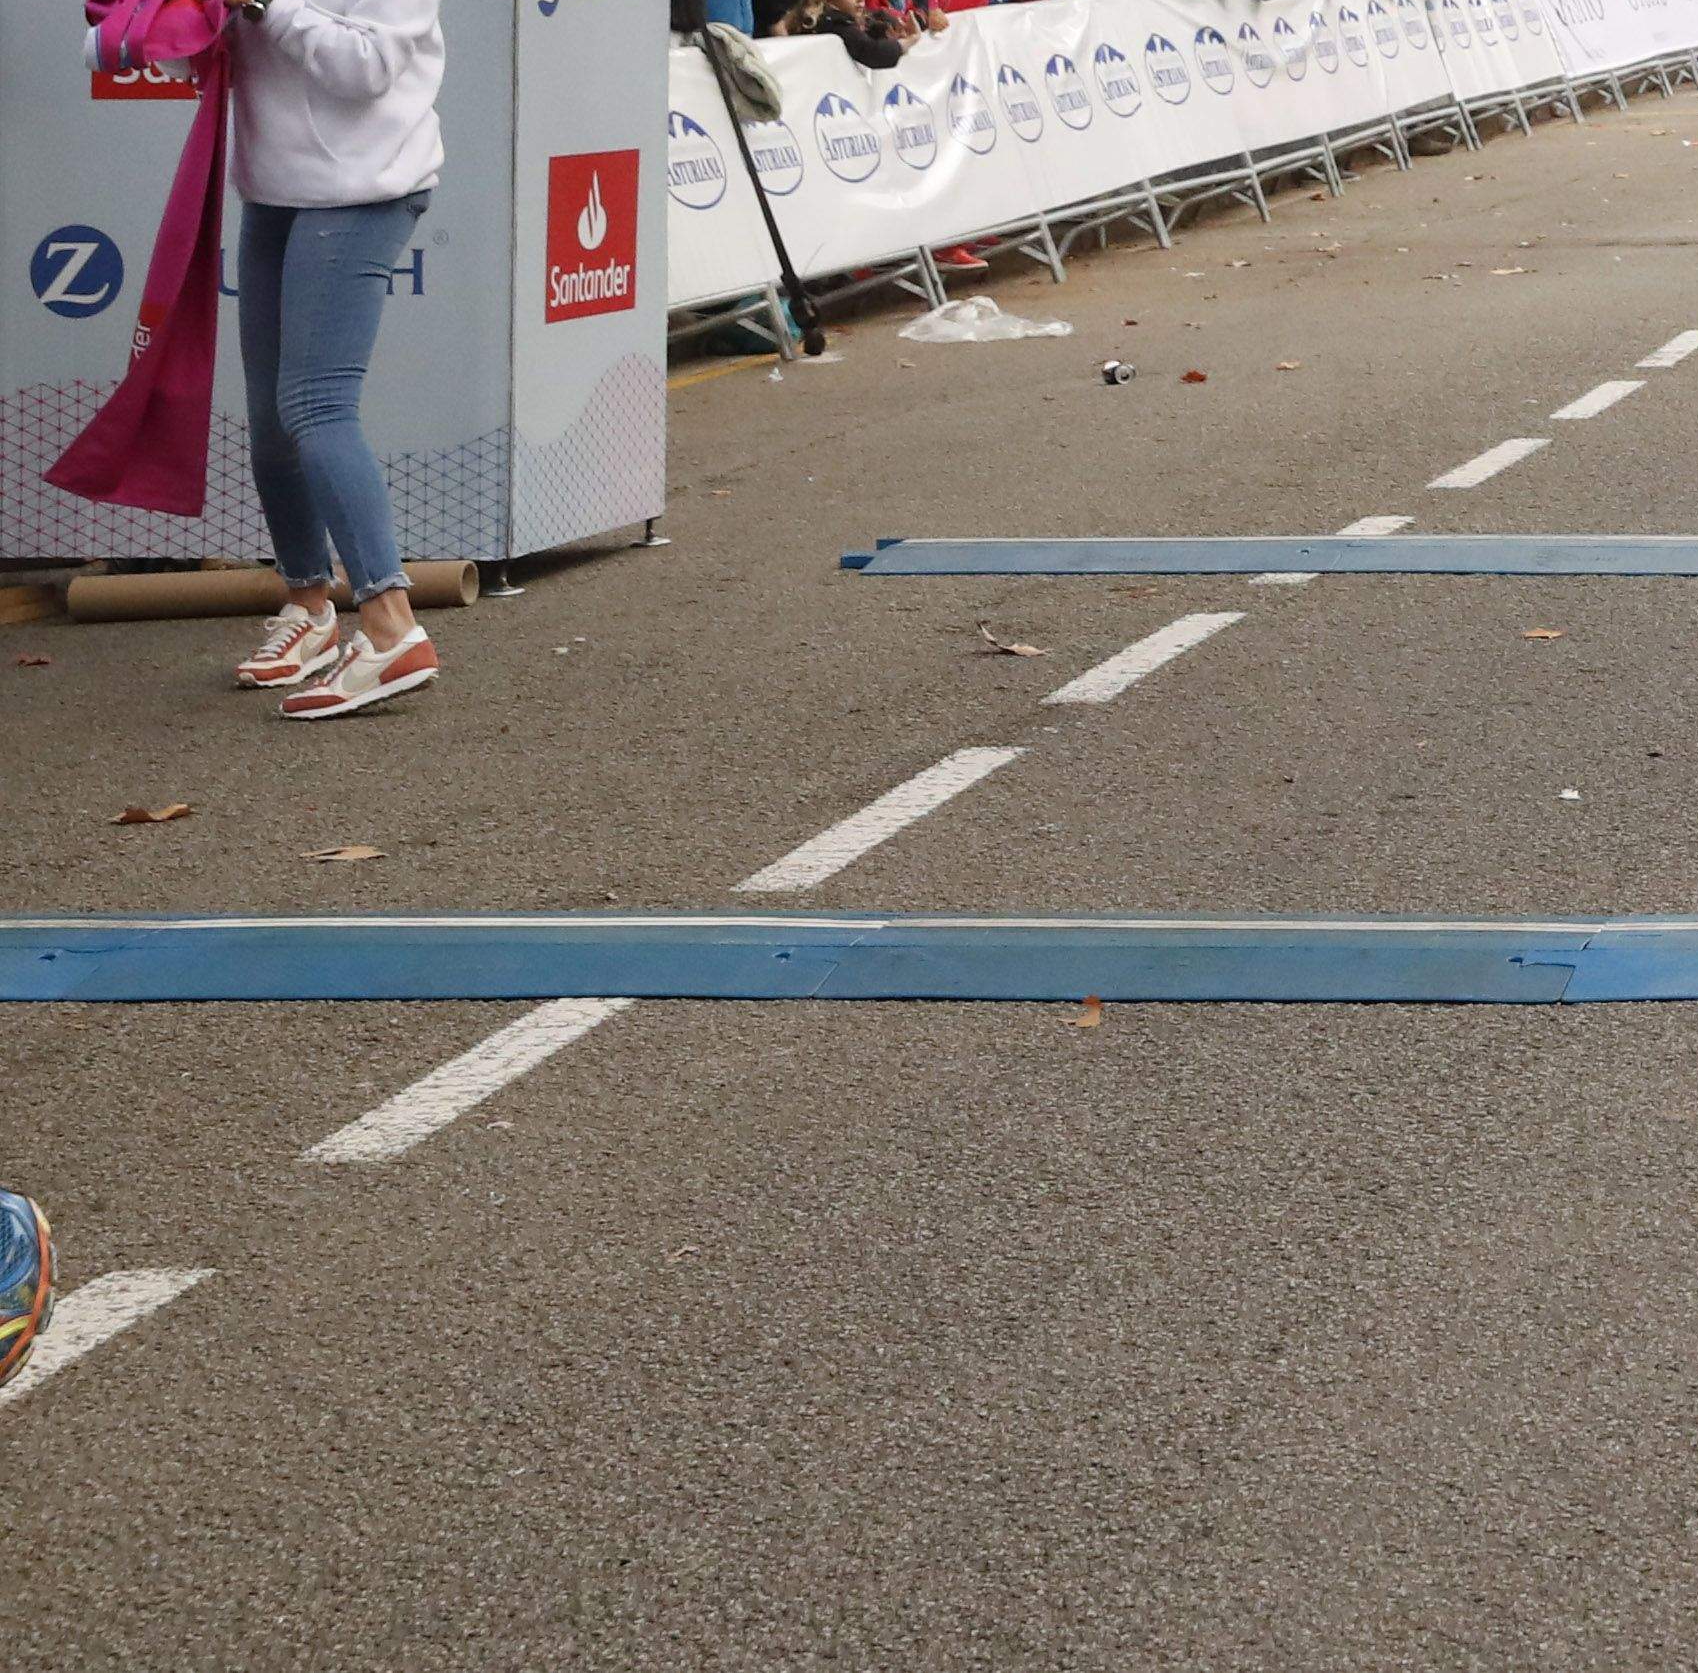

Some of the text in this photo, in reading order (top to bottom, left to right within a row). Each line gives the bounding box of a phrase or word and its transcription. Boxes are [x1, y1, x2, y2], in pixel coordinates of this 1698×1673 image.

[755, 145, 801, 173] STURIANA
[824, 128, 879, 162] ASTURIANA
[550, 261, 632, 308] Santander
